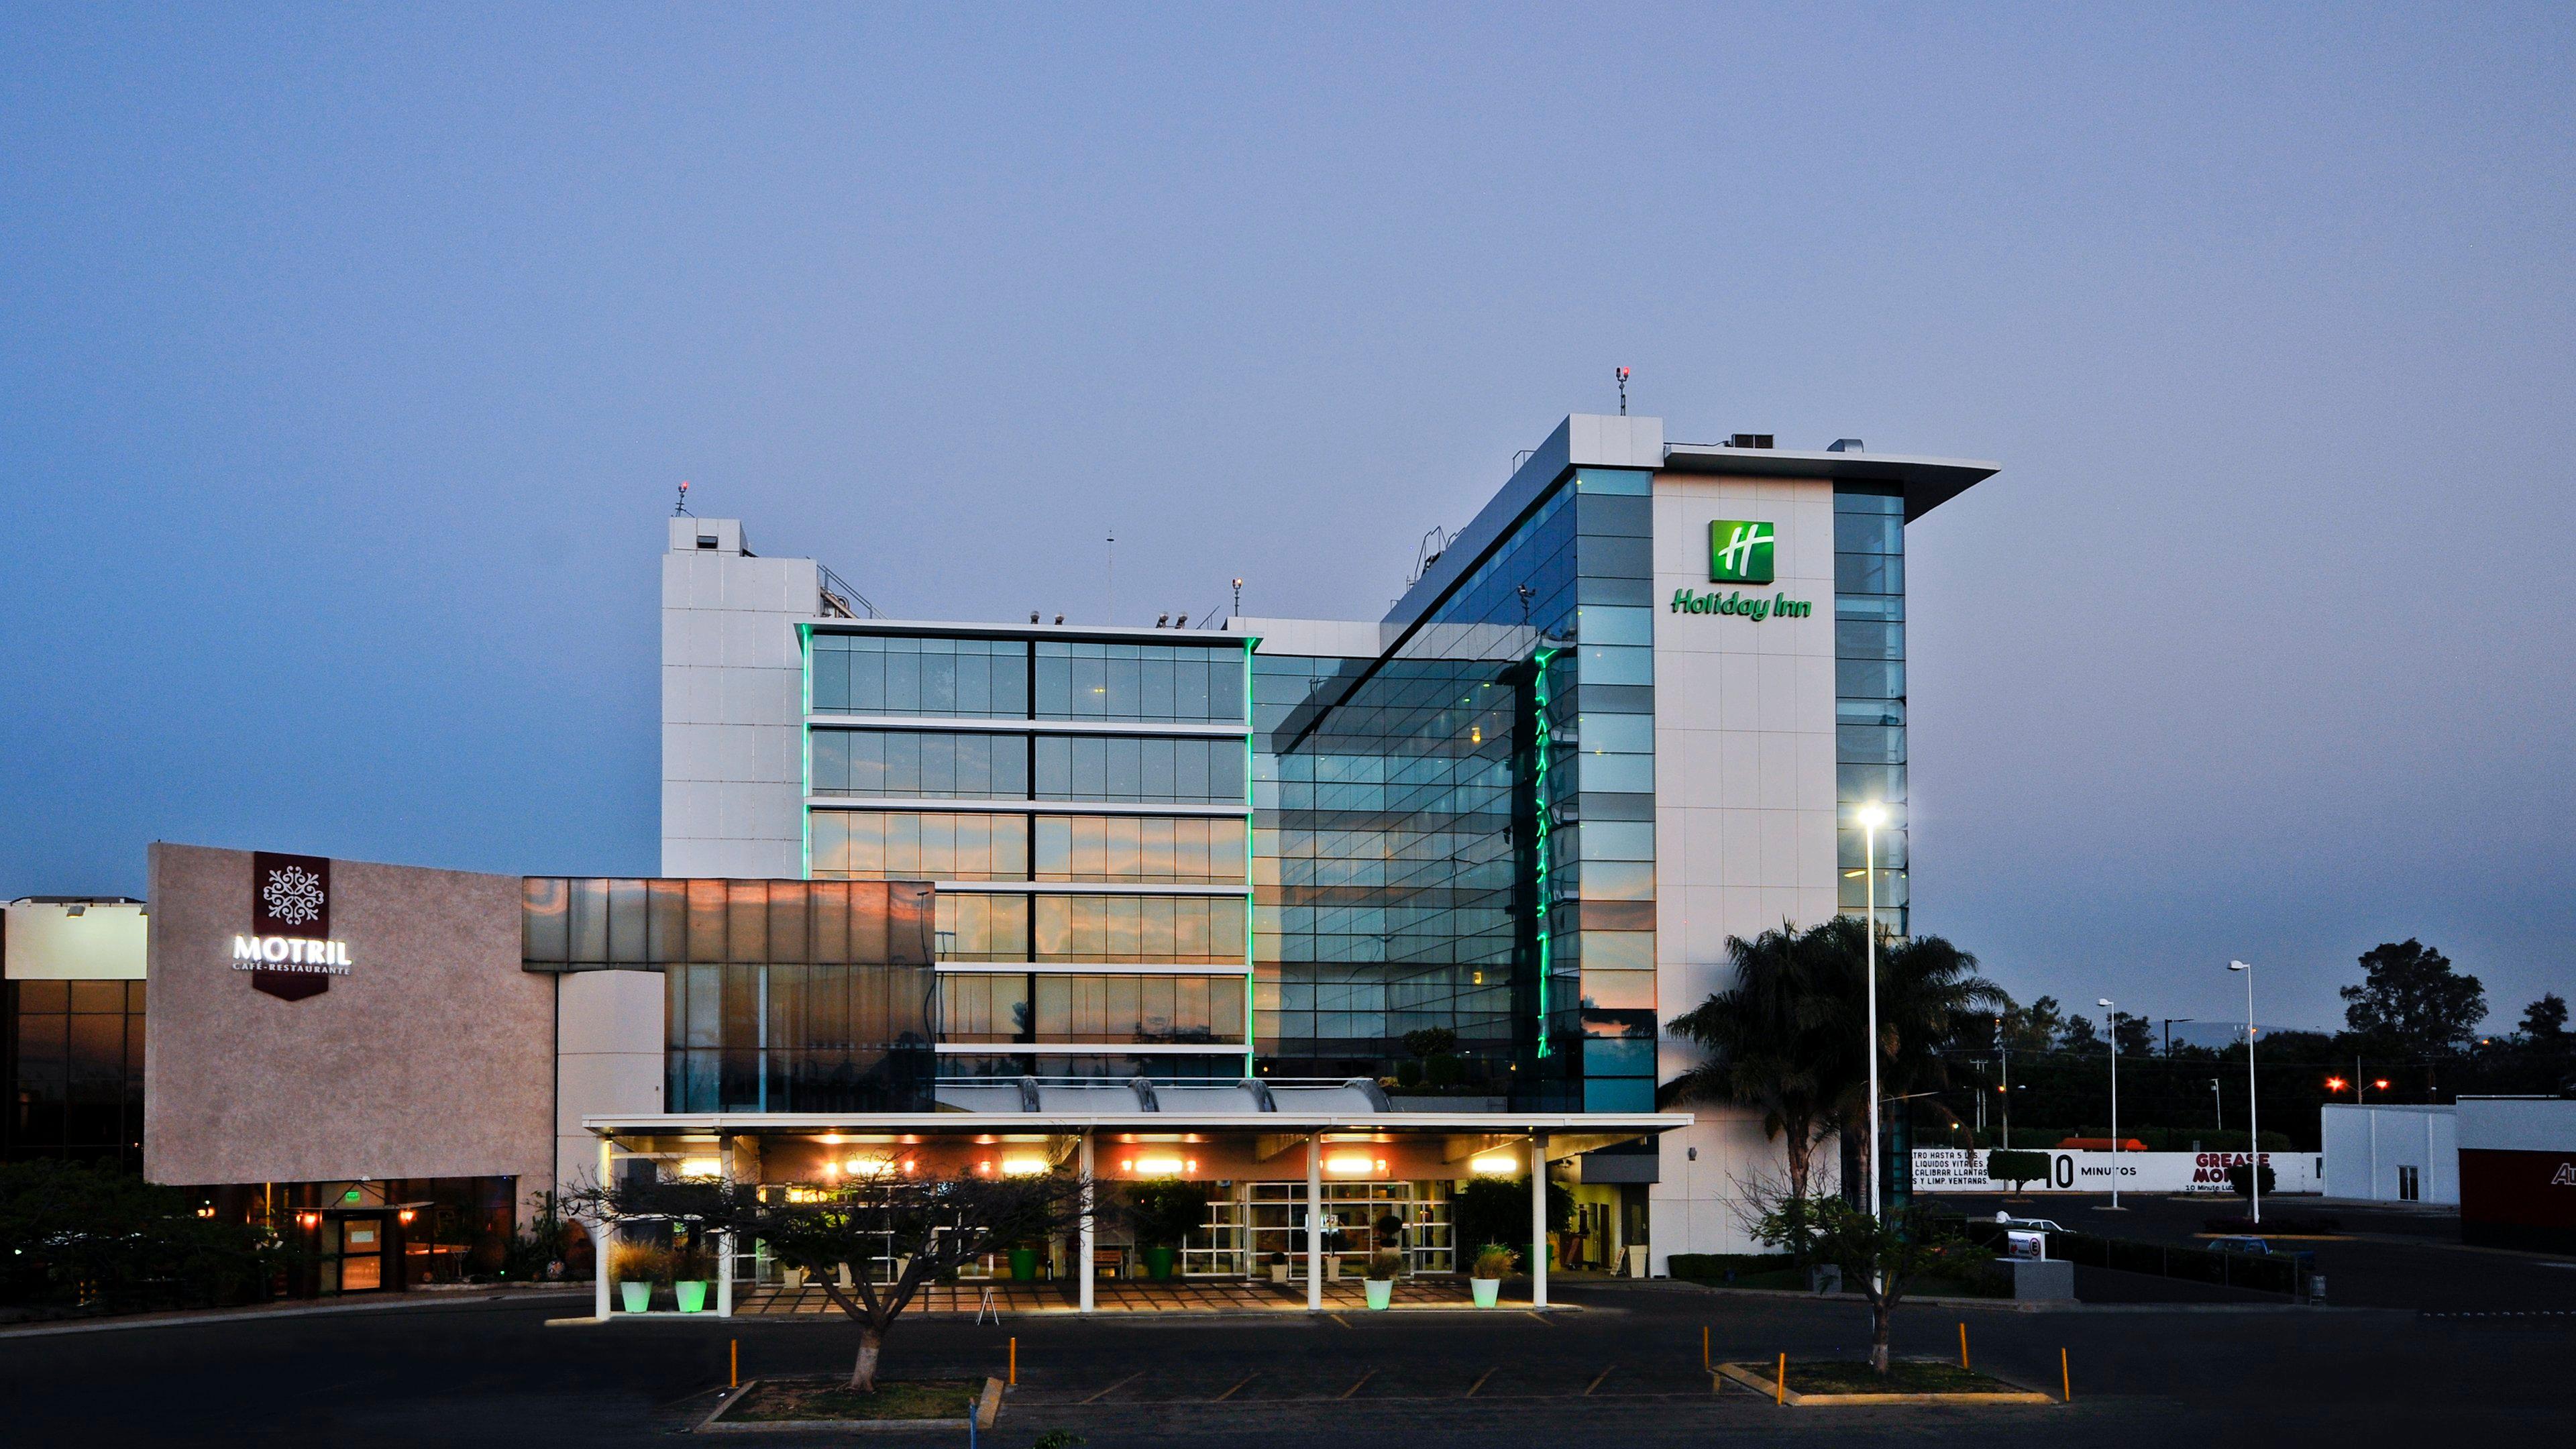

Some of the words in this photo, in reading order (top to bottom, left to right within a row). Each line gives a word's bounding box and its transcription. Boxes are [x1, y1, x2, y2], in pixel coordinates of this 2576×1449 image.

[1670, 588, 1770, 621] Holiday
[1774, 592, 1811, 617] Inn
[233, 934, 352, 965] MOTRIL
[1915, 1160, 1949, 1168] LIQUIDOS
[1953, 1169, 1988, 1177] LLANTAS
